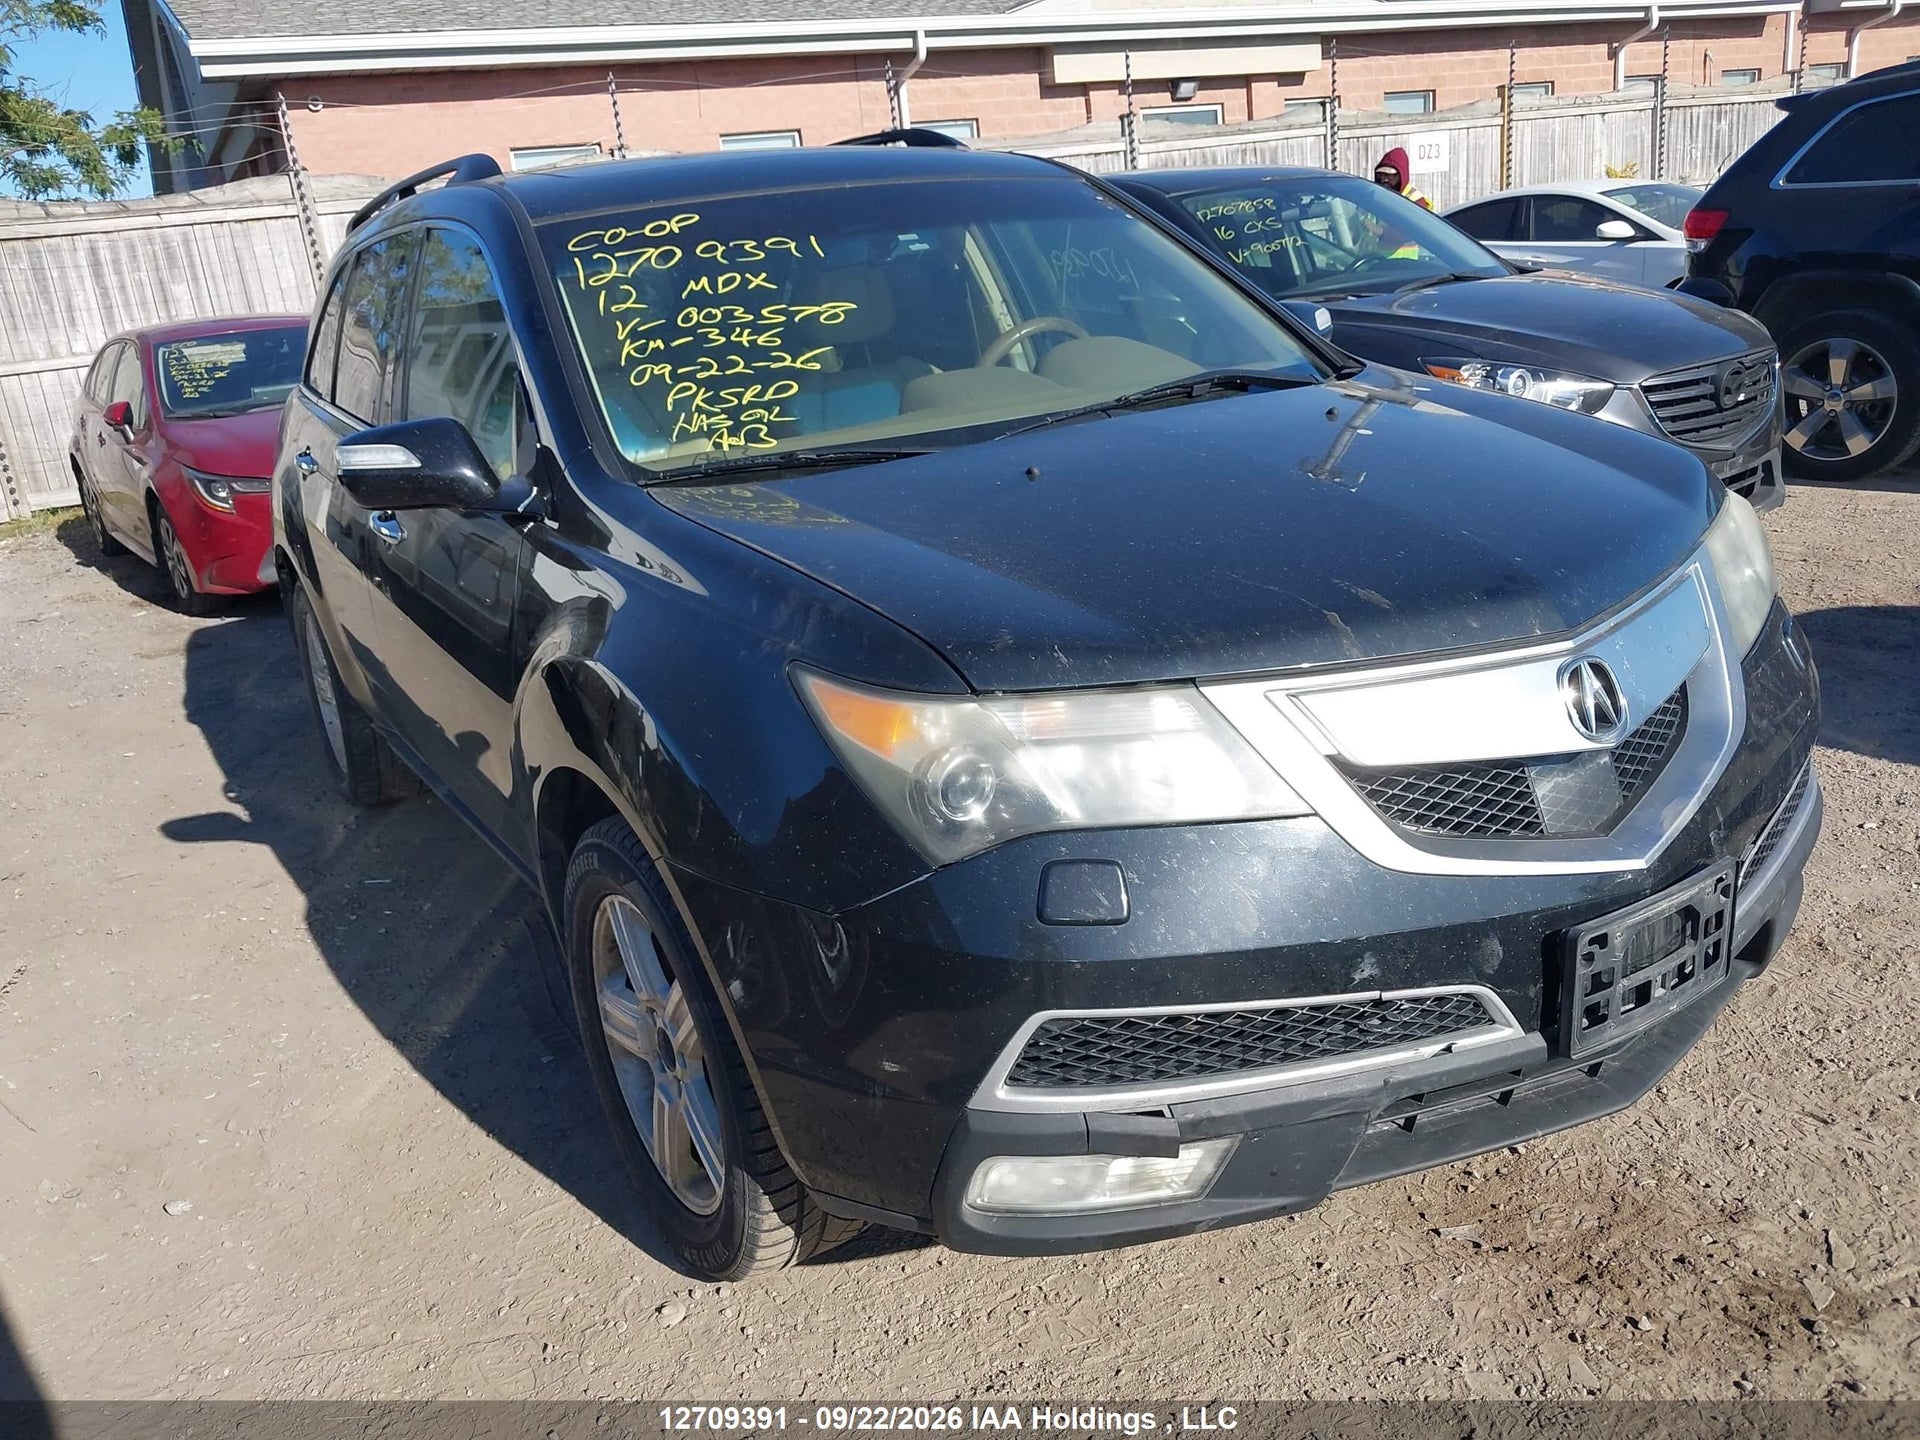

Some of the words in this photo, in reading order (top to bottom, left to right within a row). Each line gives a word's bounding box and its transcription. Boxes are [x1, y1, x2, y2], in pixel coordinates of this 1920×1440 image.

[1418, 143, 1440, 160] DZ3
[567, 213, 701, 251] CO-OP
[1213, 225, 1236, 241] 16
[598, 285, 649, 317] 12
[681, 272, 779, 300] MDX
